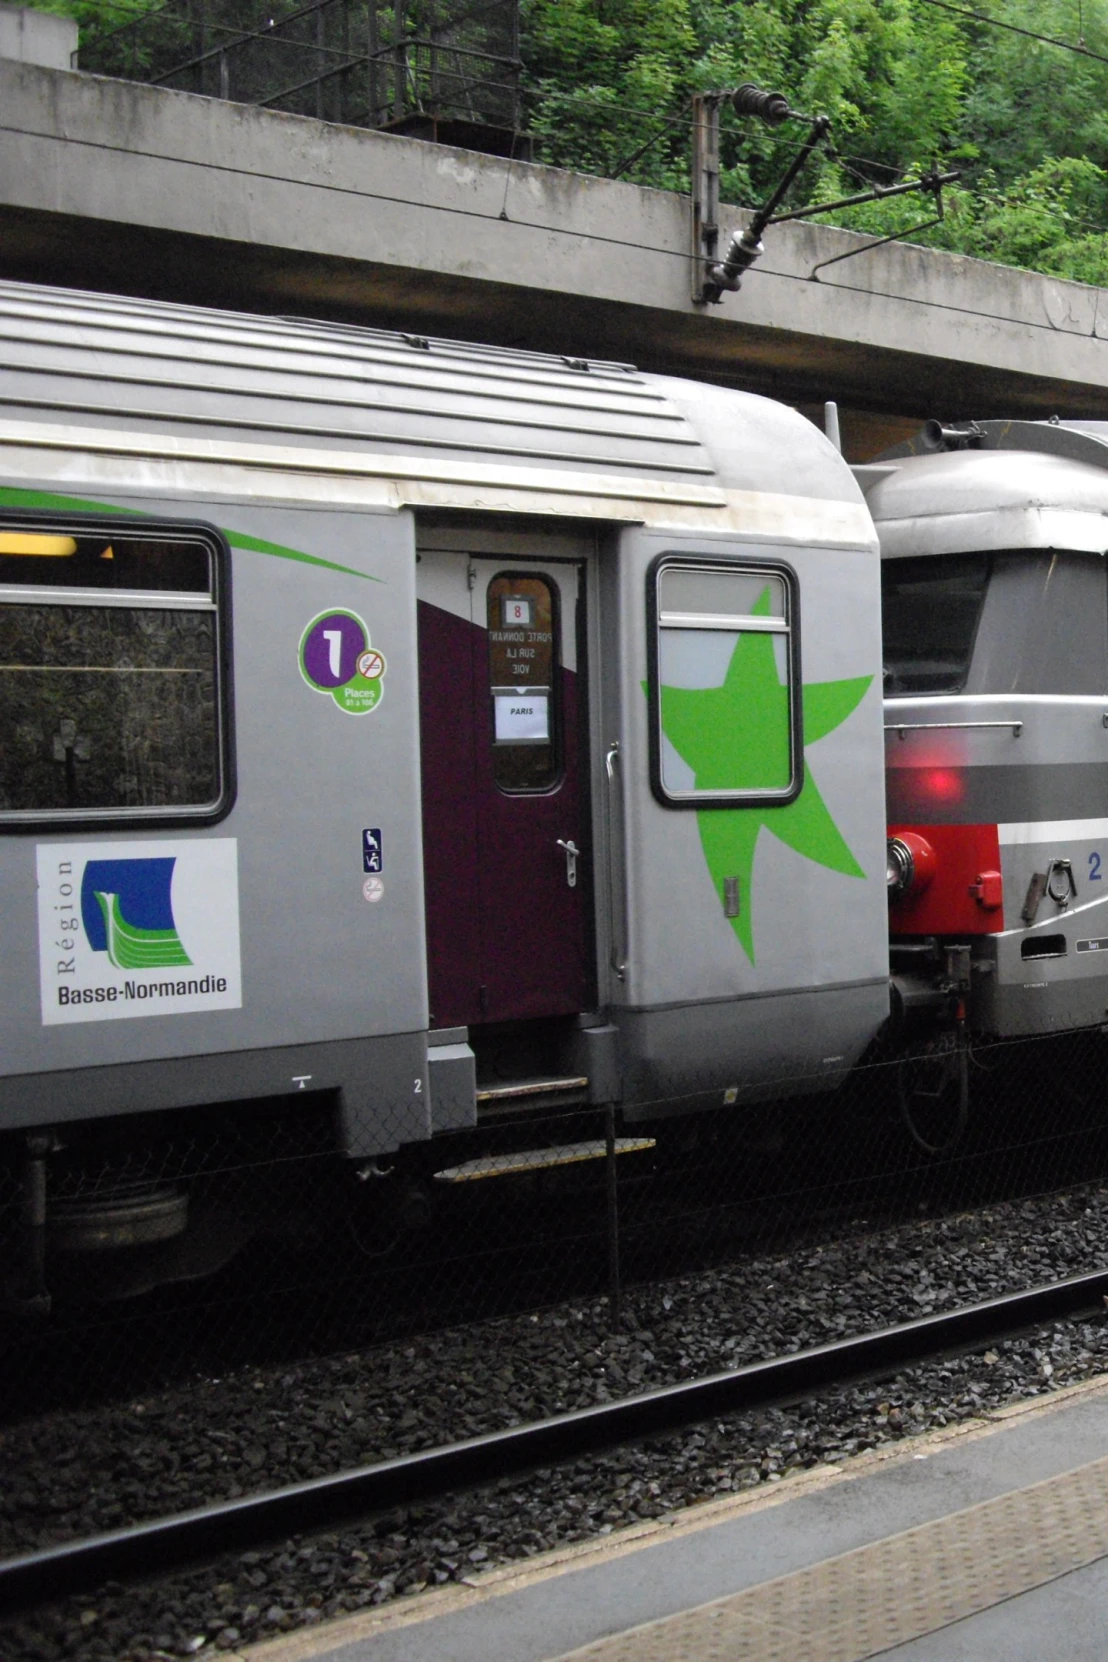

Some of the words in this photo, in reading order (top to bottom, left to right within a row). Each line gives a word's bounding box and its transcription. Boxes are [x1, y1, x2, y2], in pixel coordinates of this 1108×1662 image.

[514, 605, 522, 618] 8
[323, 630, 342, 678] 1
[344, 688, 375, 698] Places
[1088, 851, 1102, 881] 2
[55, 861, 78, 975] Région
[58, 975, 227, 1006] Basse-Normandie
[414, 1078, 422, 1093] 2
